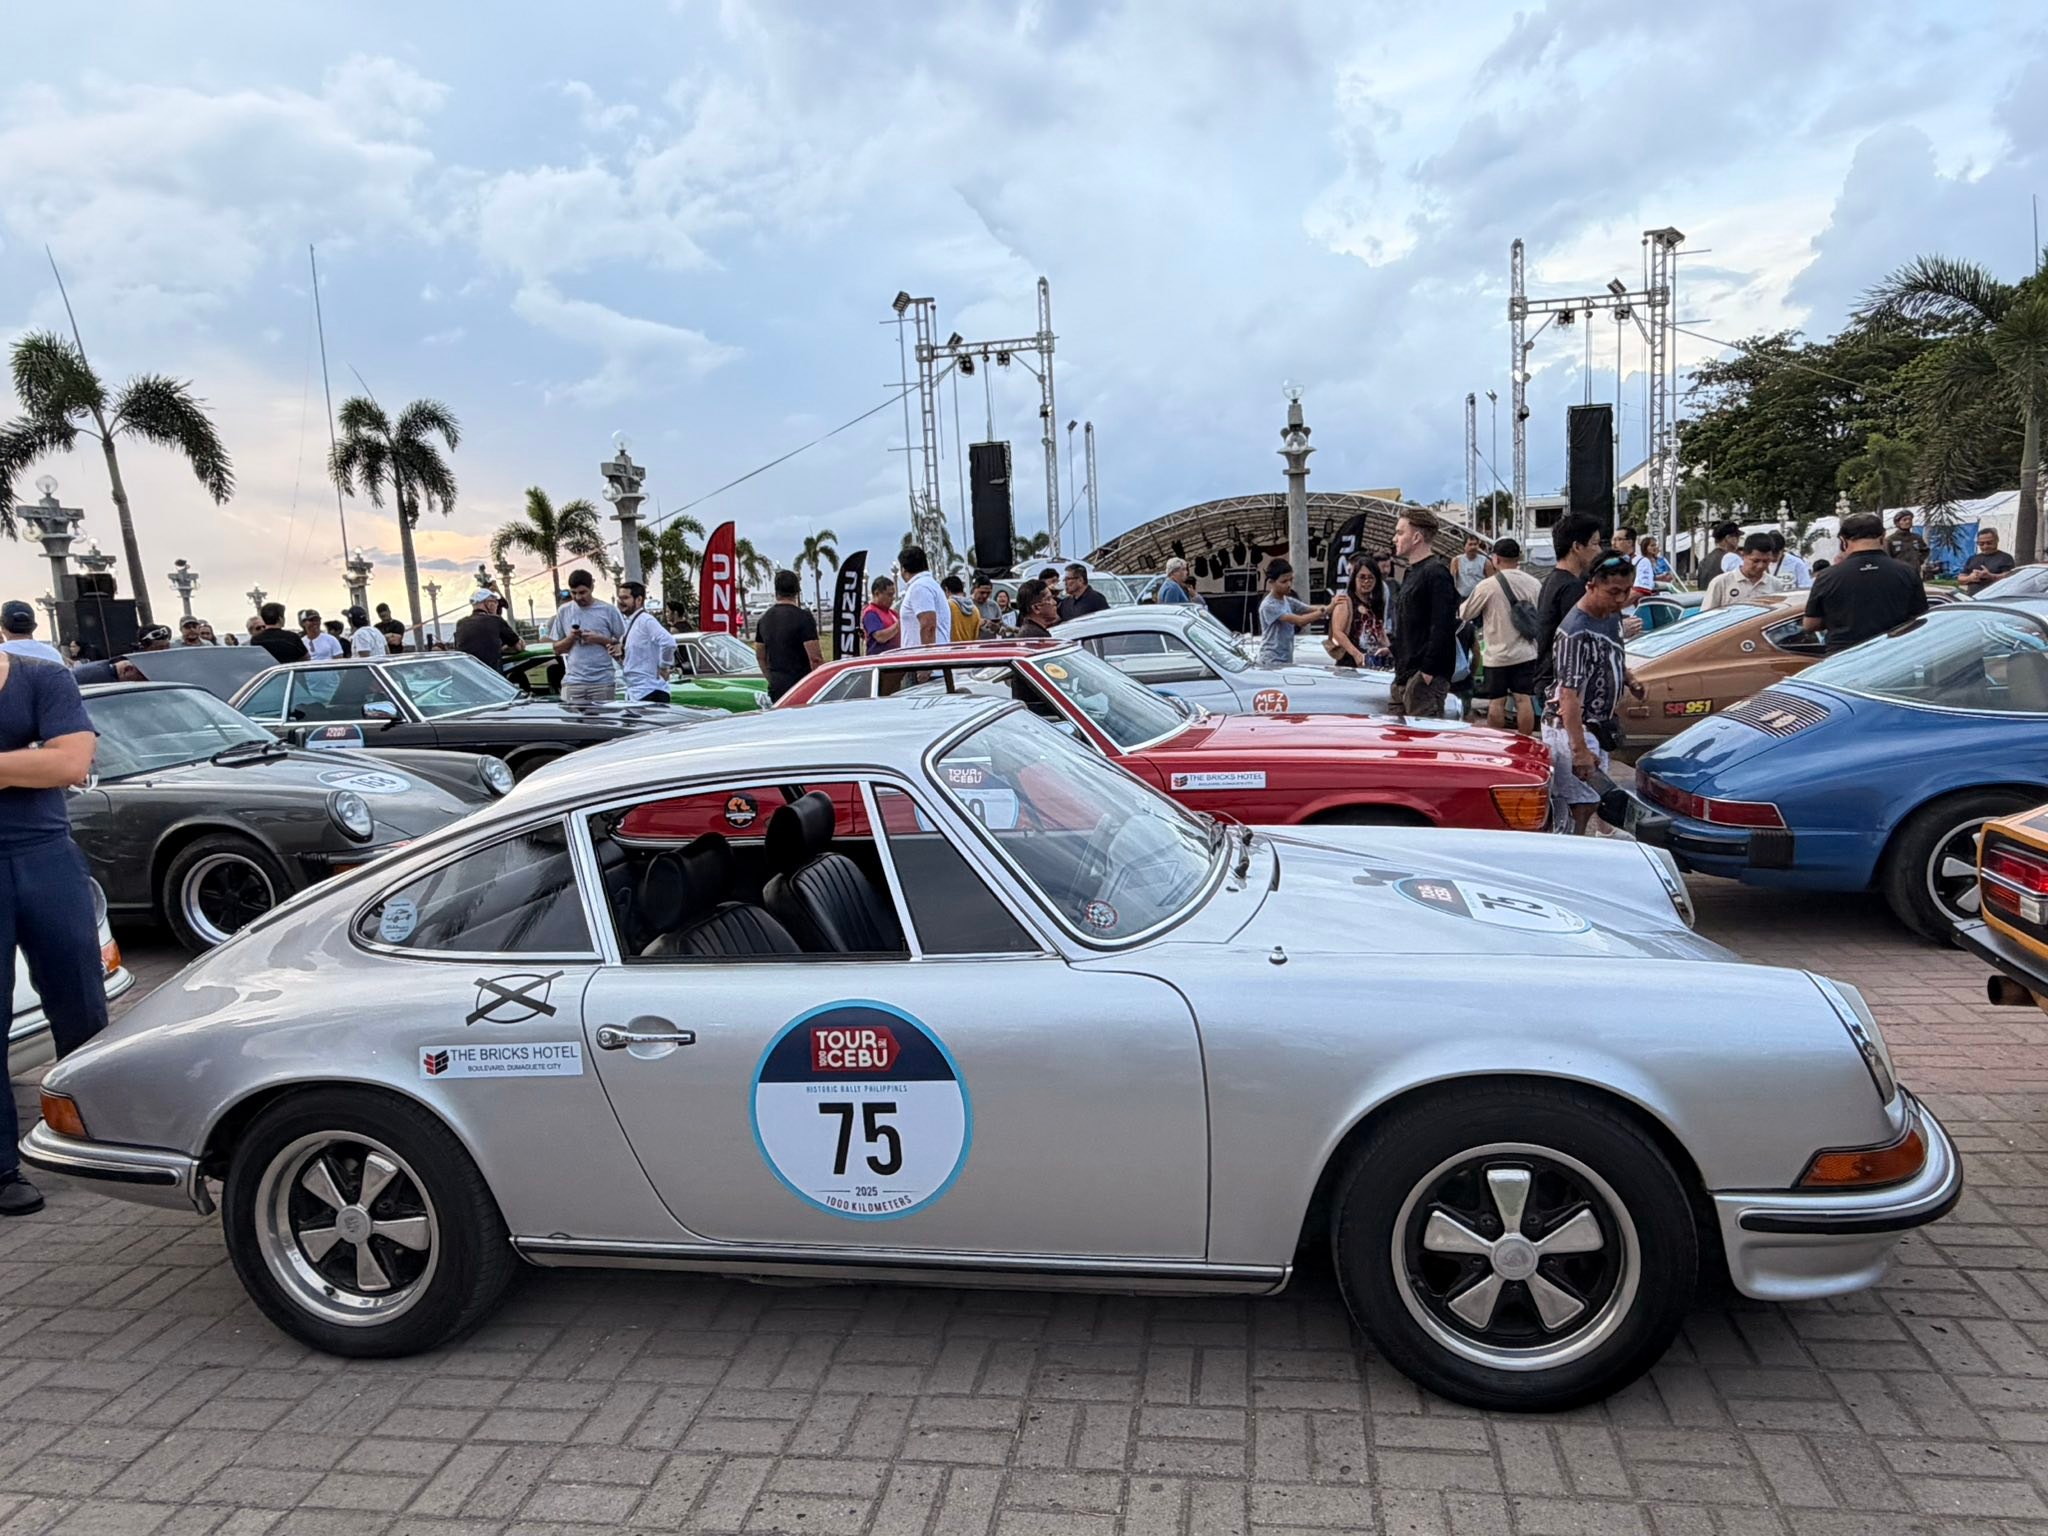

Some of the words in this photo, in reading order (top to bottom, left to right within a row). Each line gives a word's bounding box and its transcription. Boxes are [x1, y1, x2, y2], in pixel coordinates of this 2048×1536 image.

[1255, 693, 1285, 702] MEZ
[1476, 892, 1551, 919] 75
[816, 1030, 877, 1049] TOUR
[450, 1049, 476, 1062] THE
[480, 1047, 529, 1061] BRICKS
[533, 1046, 578, 1059] HOTEL
[827, 1048, 889, 1068] CEBU
[806, 1085, 838, 1093] HISTORIC
[840, 1085, 861, 1093] RALLY
[864, 1085, 908, 1093] PHILIPPINES
[818, 1102, 902, 1175] 75
[855, 1186, 879, 1197] 2025
[826, 1195, 849, 1210] 1000
[851, 1195, 912, 1212] KILOMETERS
